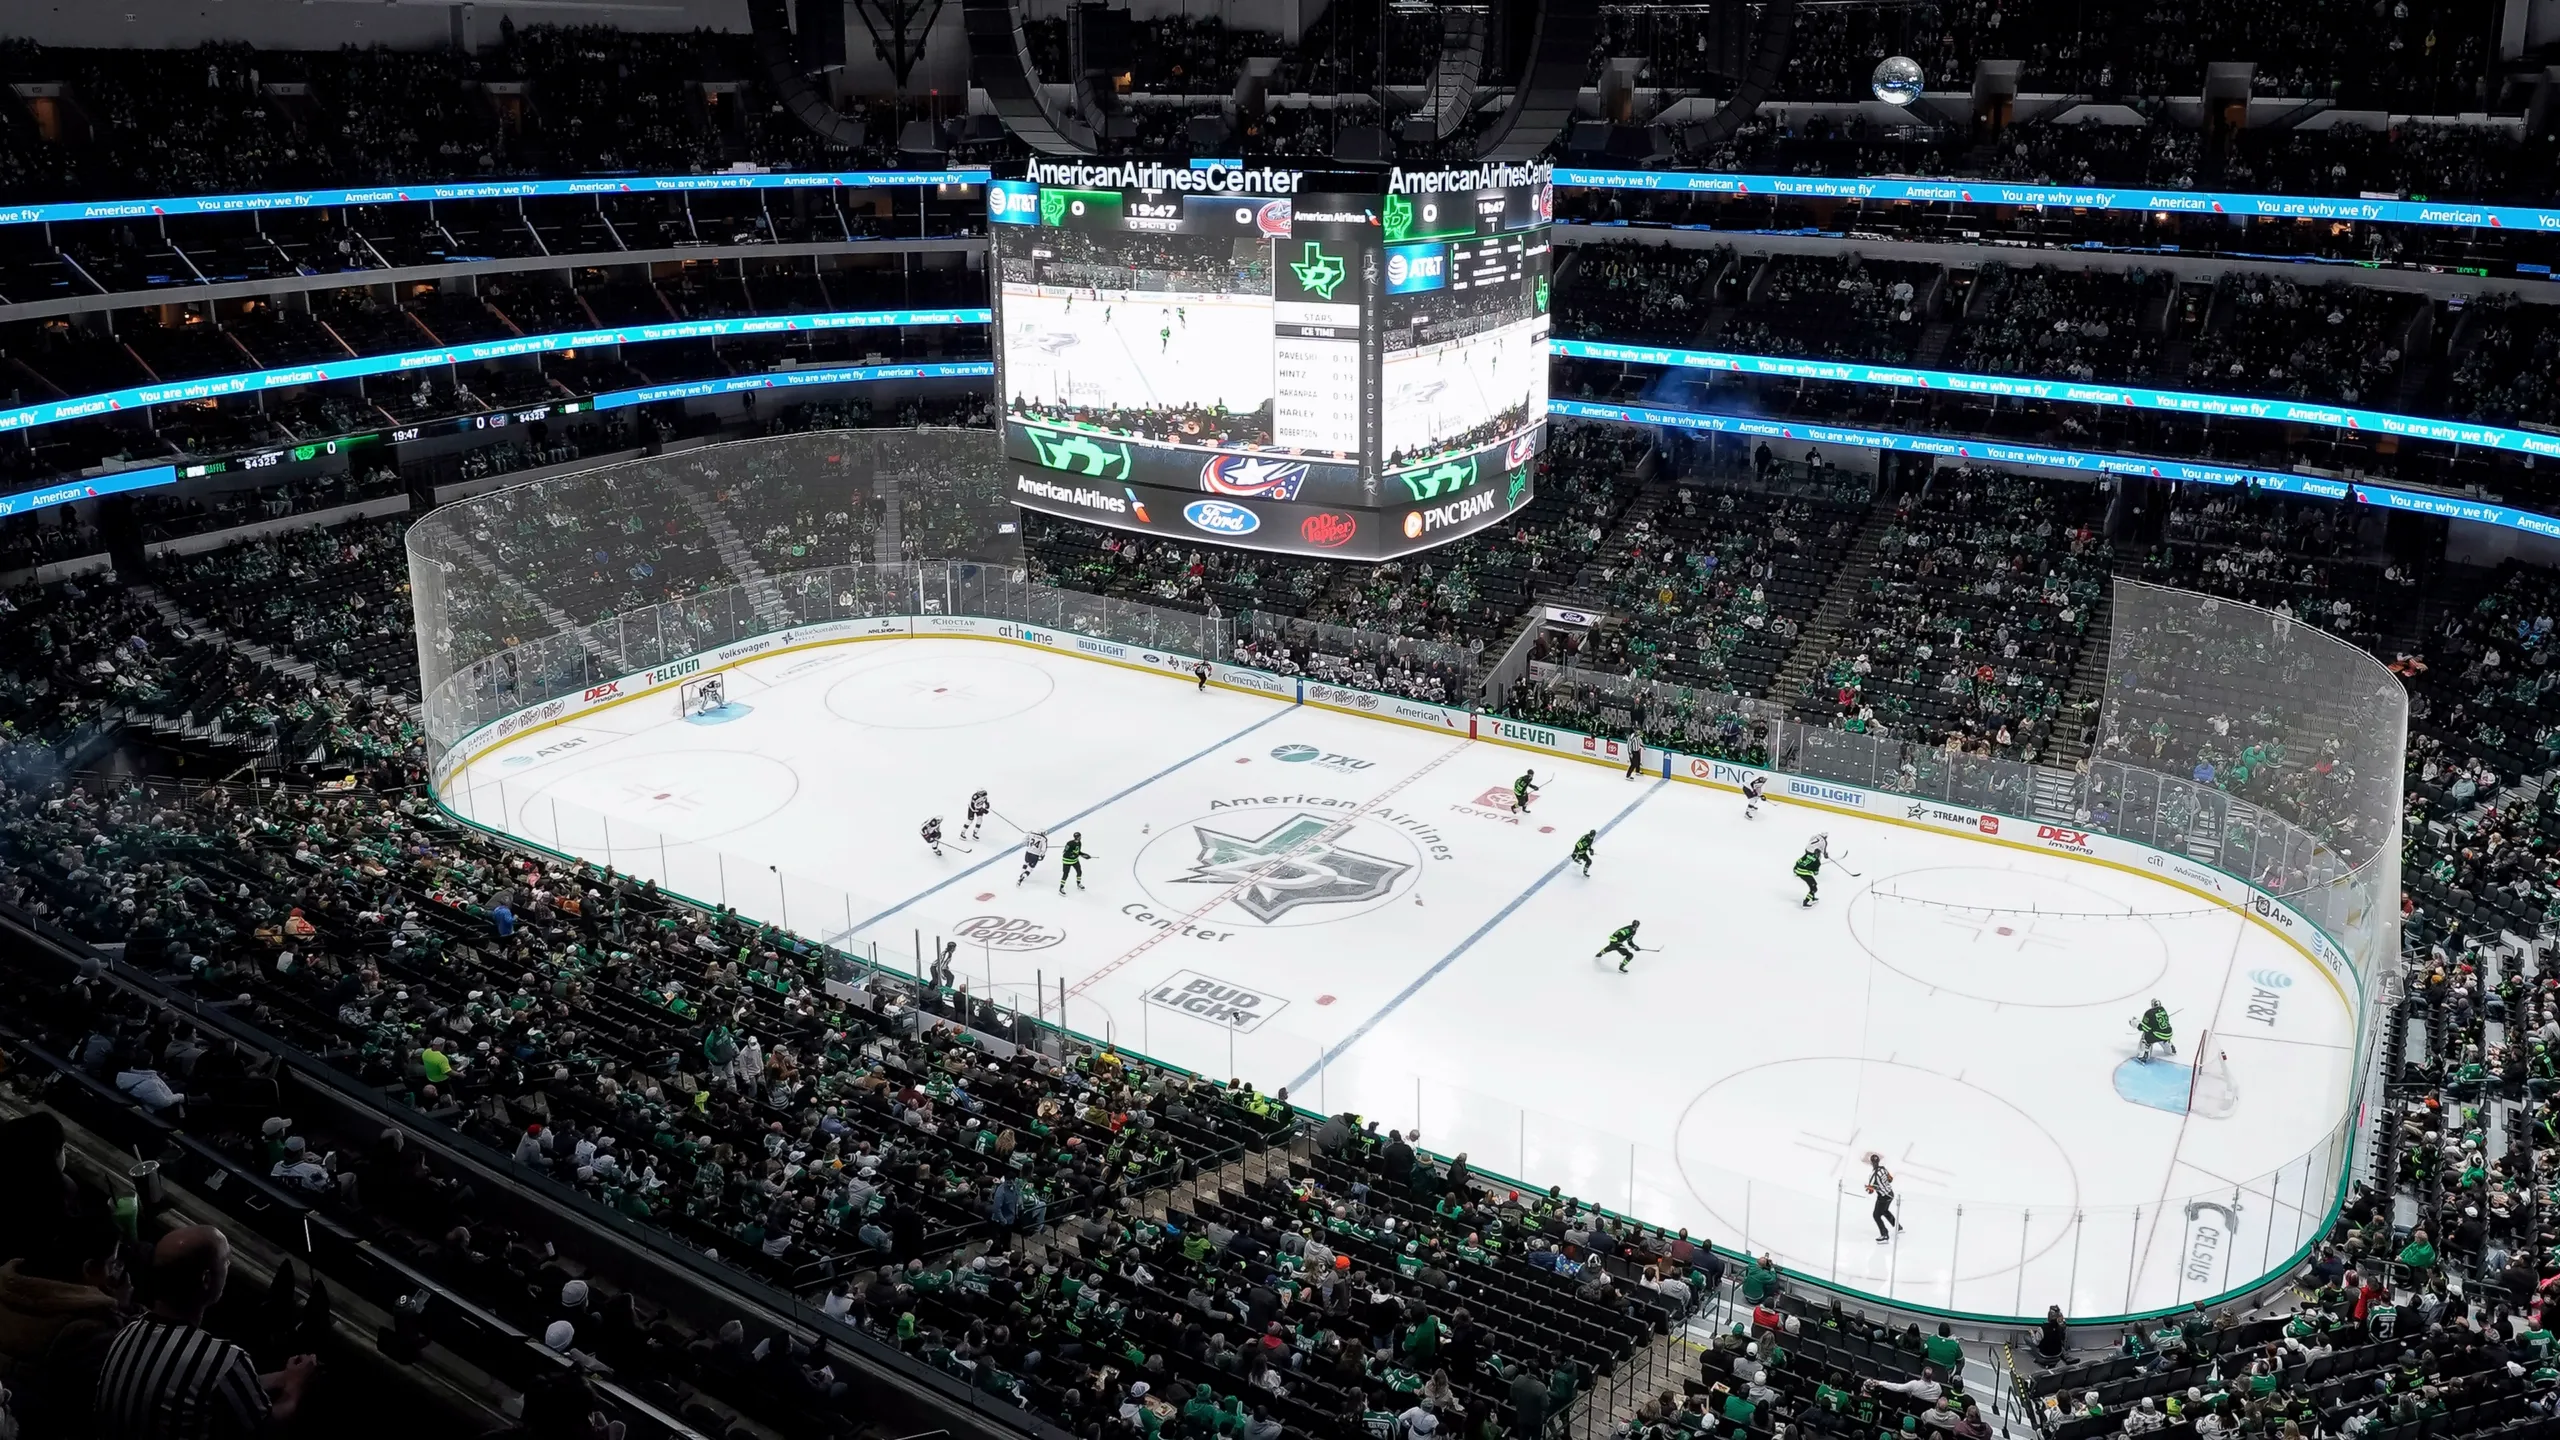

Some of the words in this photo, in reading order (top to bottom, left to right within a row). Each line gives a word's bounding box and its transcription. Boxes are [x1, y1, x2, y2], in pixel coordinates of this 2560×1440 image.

[1688, 178, 1733, 189] American
[1774, 181, 1793, 192] You
[1795, 183, 1813, 192] are
[1815, 183, 1837, 195] why
[1840, 186, 1856, 194] we
[345, 192, 394, 202] American
[1906, 186, 1956, 198] American
[85, 205, 146, 216] American
[197, 201, 221, 210] You
[223, 200, 243, 209] are
[246, 198, 271, 207] why
[274, 198, 292, 206] we
[1007, 194, 1037, 212] AT&T
[1071, 200, 1084, 216] 0
[1130, 203, 1176, 217] 19:47
[2149, 196, 2206, 209] American
[2257, 200, 2280, 212] You
[2283, 204, 2305, 214] are
[2308, 203, 2336, 217] why
[2339, 207, 2359, 216] we
[1235, 208, 1252, 224] 0
[1294, 211, 1334, 222] American
[1334, 212, 1366, 223] Airlines
[1422, 204, 1438, 222] 0
[1409, 256, 1443, 278] AT&T
[1304, 313, 1333, 322] STARS
[1301, 327, 1314, 336] ICE
[1315, 328, 1335, 338] TIME
[400, 354, 443, 367] American
[1684, 354, 1727, 368] American
[805, 375, 819, 383] are
[820, 373, 838, 381] why
[1279, 370, 1307, 379] HINTZ
[139, 392, 161, 402] You
[163, 389, 182, 399] are
[184, 385, 209, 396] why
[211, 383, 229, 393] we
[726, 380, 762, 390] American
[2067, 388, 2118, 402] American
[55, 401, 105, 418] American
[1279, 408, 1314, 418] HARLEY
[476, 417, 484, 429] 0
[2382, 418, 2405, 432] You
[2407, 424, 2429, 435] are
[2431, 426, 2459, 441] why
[2461, 431, 2481, 442] we
[392, 428, 418, 441] 19:47
[326, 441, 336, 454] 0
[245, 456, 277, 469] $4325
[32, 489, 81, 506] American
[1017, 474, 1072, 503] American
[1073, 487, 1126, 513] Airlines
[1424, 505, 1459, 531] PNC
[1459, 489, 1495, 521] BANK
[2390, 494, 2411, 507] You
[2413, 500, 2433, 510] are
[2435, 503, 2460, 516] why
[2463, 507, 2481, 518] we
[1198, 504, 1244, 530] Ford
[1320, 513, 1339, 527] Dr
[1302, 516, 1351, 543] Pepper
[999, 625, 1013, 638] at
[718, 641, 770, 661] Volkswagen
[1079, 640, 1098, 651] BUD
[1098, 644, 1125, 657] LIGHT
[583, 681, 619, 702] DEX
[1263, 680, 1285, 693] Bank
[1395, 705, 1440, 723] American
[536, 736, 588, 758] AT&T
[1319, 753, 1376, 769] TXU
[1791, 782, 1819, 796] BUD
[1822, 787, 1862, 804] LIGHT
[1209, 794, 1358, 809] American
[1450, 804, 1519, 825] TOYOTA
[1932, 810, 1964, 824] STREAM
[1966, 816, 1977, 826] ON
[1369, 807, 1454, 862] Airlines
[2037, 826, 2090, 847] DEX
[2048, 840, 2094, 855] imaging
[955, 916, 1057, 945] Pepper
[1001, 919, 1044, 932] Dr
[1122, 903, 1236, 943] Center
[2322, 947, 2343, 975] AT&T
[1184, 978, 1262, 1009] BUD
[1151, 985, 1263, 1028] LIGHT
[2246, 986, 2280, 1027] AT&T
[2187, 1226, 2220, 1283] CELSIUS
